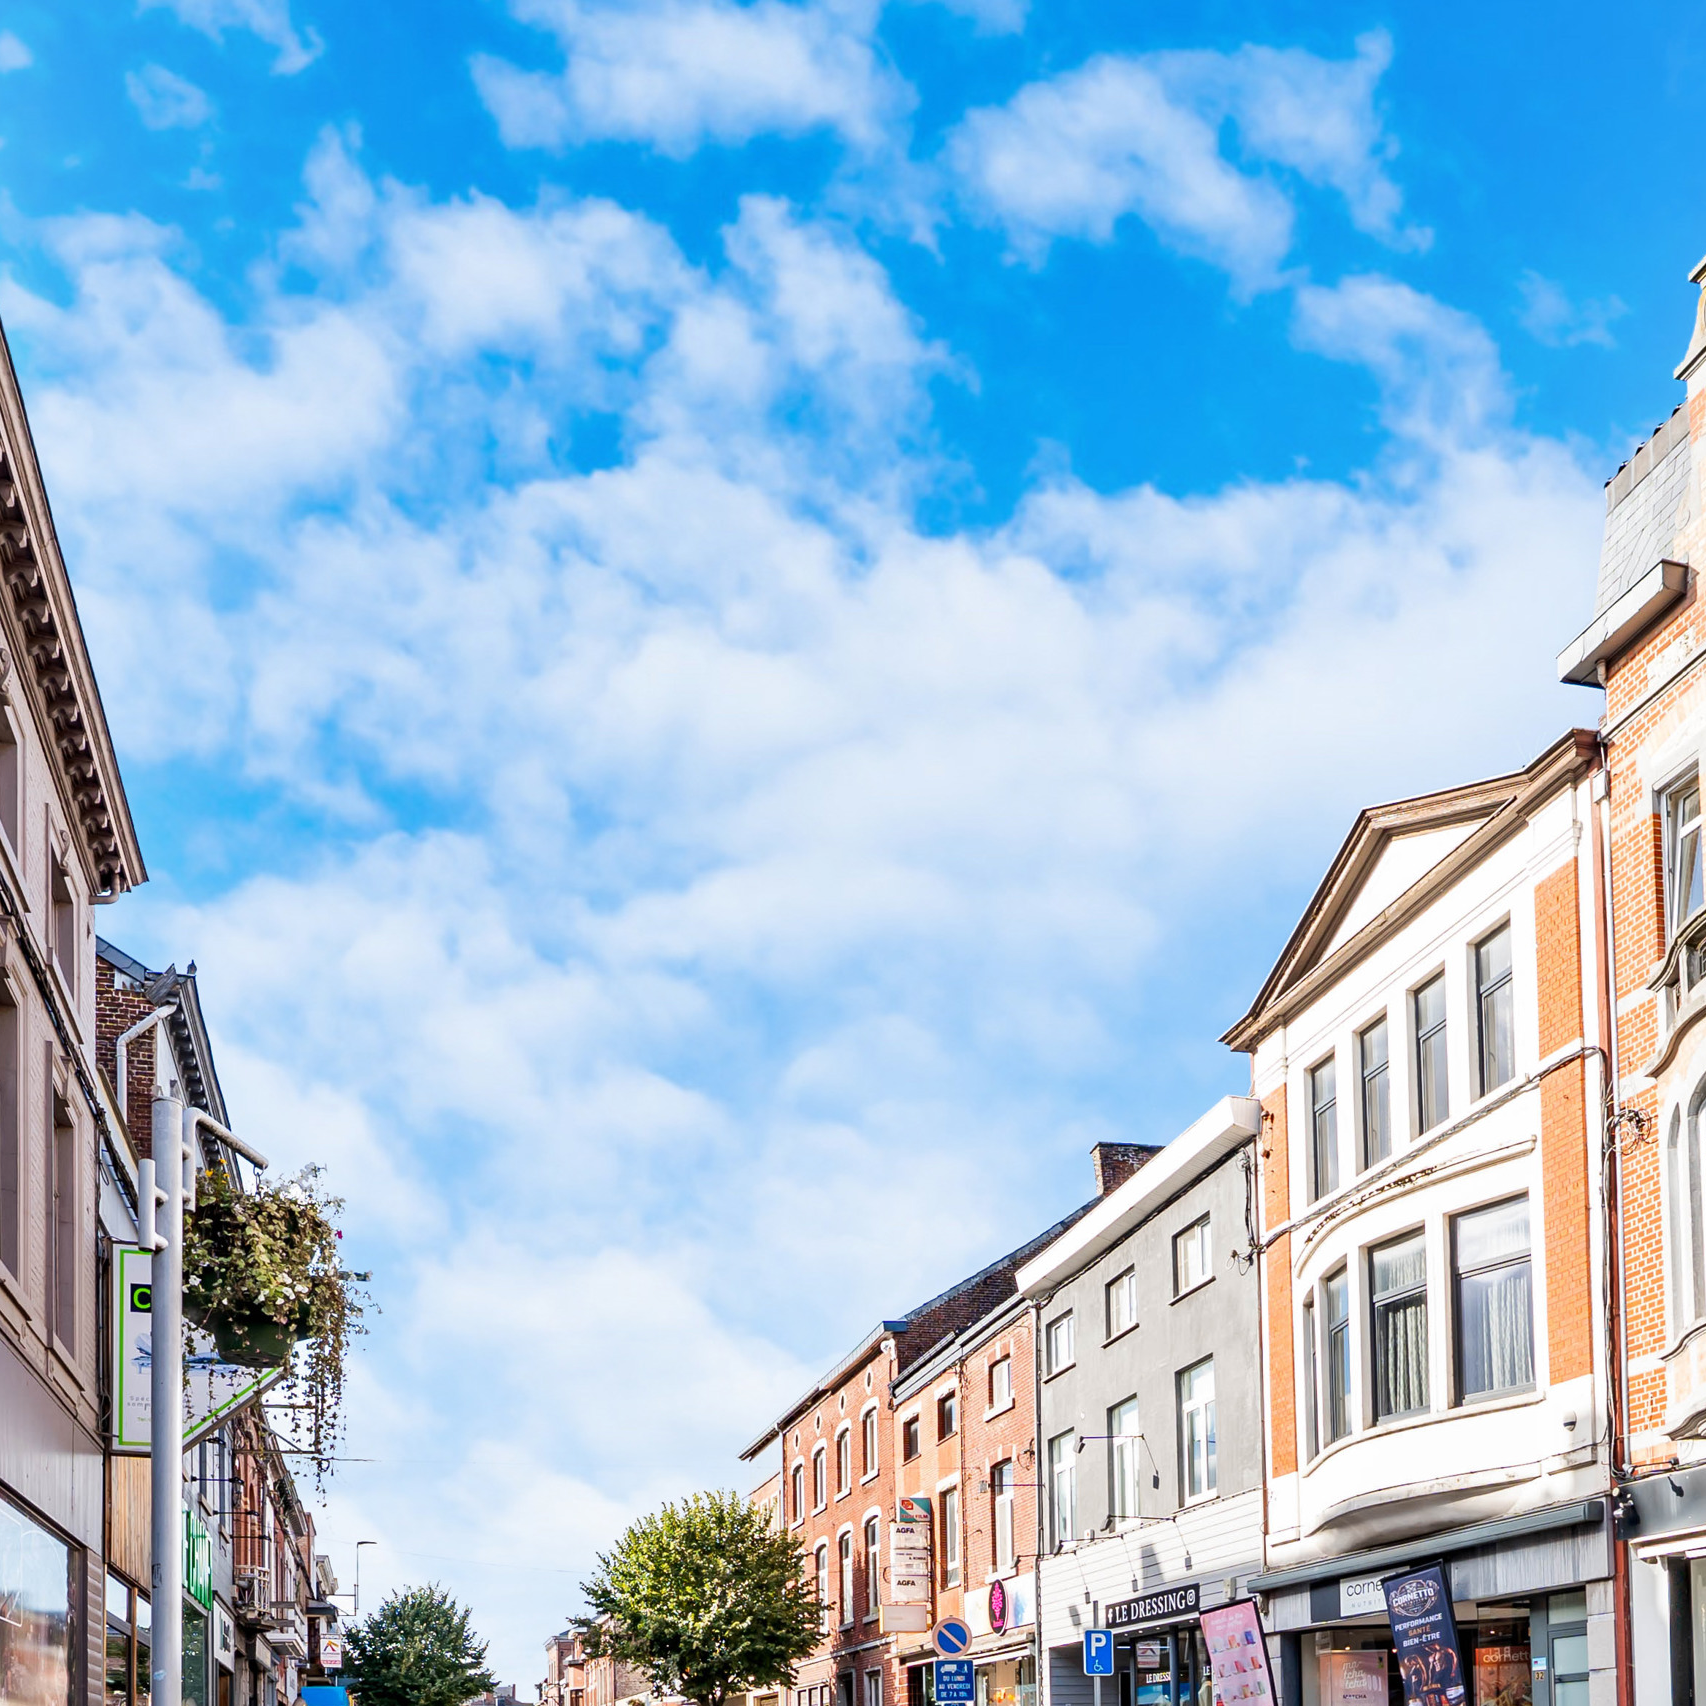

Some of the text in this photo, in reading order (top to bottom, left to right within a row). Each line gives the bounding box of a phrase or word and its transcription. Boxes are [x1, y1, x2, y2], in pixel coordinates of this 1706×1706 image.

[1346, 1580, 1383, 1597] corne
[1392, 1588, 1434, 1607] CORNETTO
[1115, 1604, 1128, 1624] LE
[1131, 1590, 1186, 1620] DRESSING
[1394, 1612, 1443, 1632] PERFORMANCE
[1408, 1624, 1431, 1637] SANTÉ
[1402, 1631, 1441, 1647] BIEN-ÊTRE
[1482, 1649, 1532, 1664] cornett
